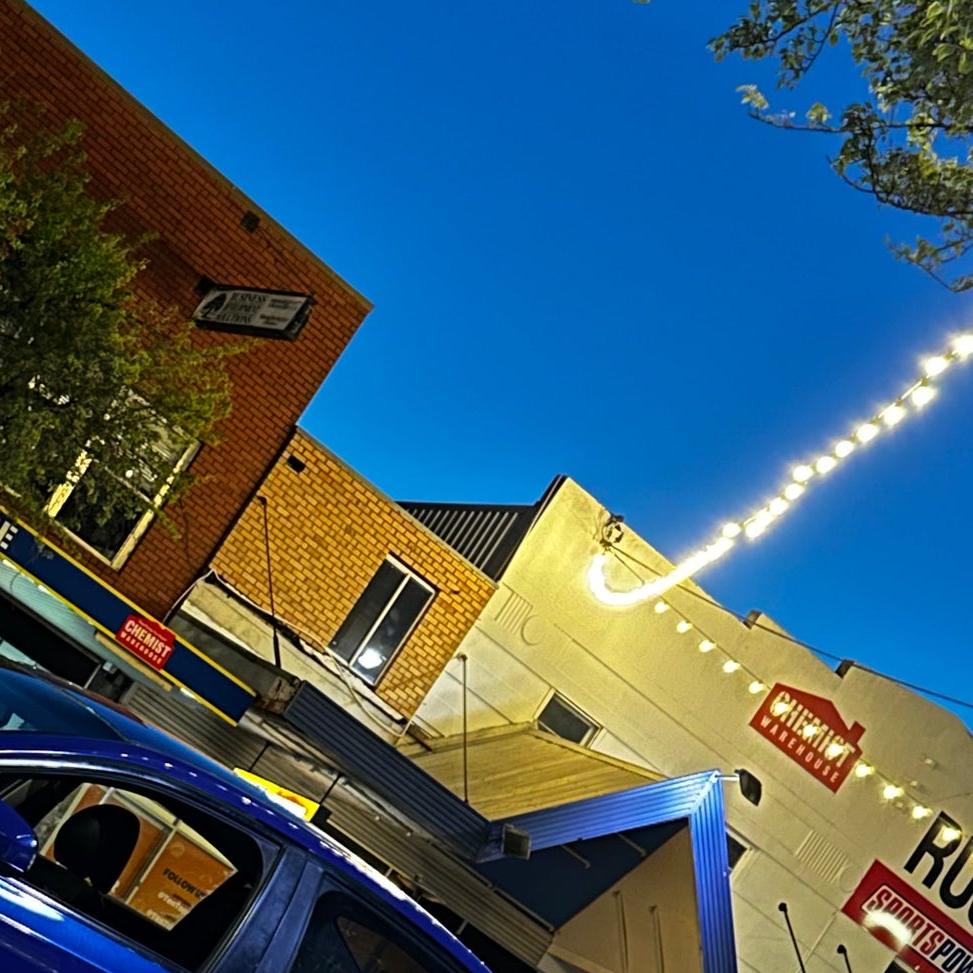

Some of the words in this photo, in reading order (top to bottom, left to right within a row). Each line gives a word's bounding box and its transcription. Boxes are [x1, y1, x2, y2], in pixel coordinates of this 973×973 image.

[124, 619, 172, 658] CHEMIST
[760, 715, 840, 783] WAREHOUSE
[162, 867, 197, 895] FOLLOW
